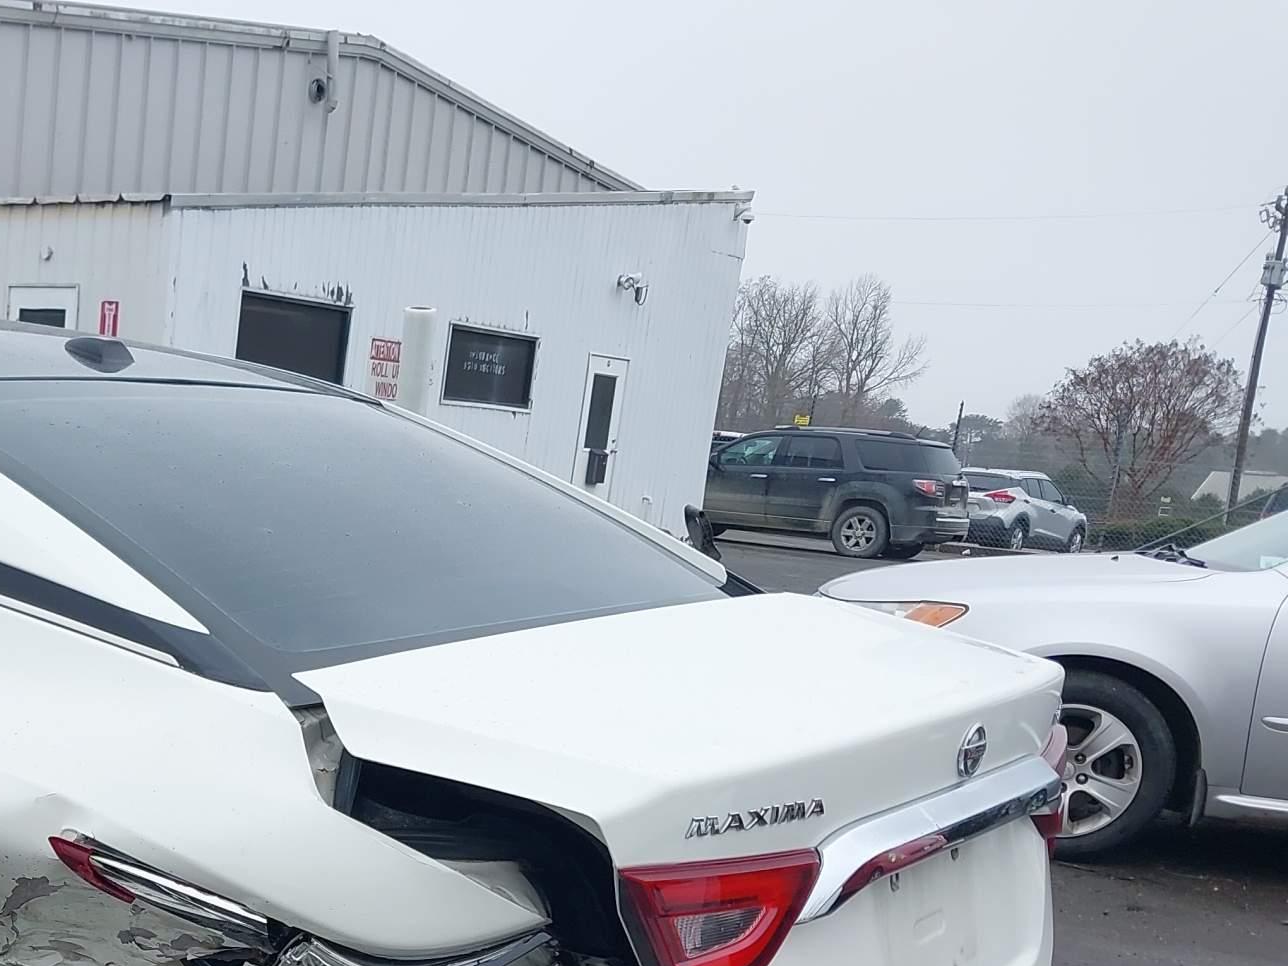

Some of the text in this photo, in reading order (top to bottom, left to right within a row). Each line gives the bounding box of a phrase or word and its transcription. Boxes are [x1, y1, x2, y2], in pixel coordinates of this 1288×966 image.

[371, 361, 389, 378] ROLL
[375, 380, 398, 399] WINDO
[684, 797, 826, 840] MAXIMA
